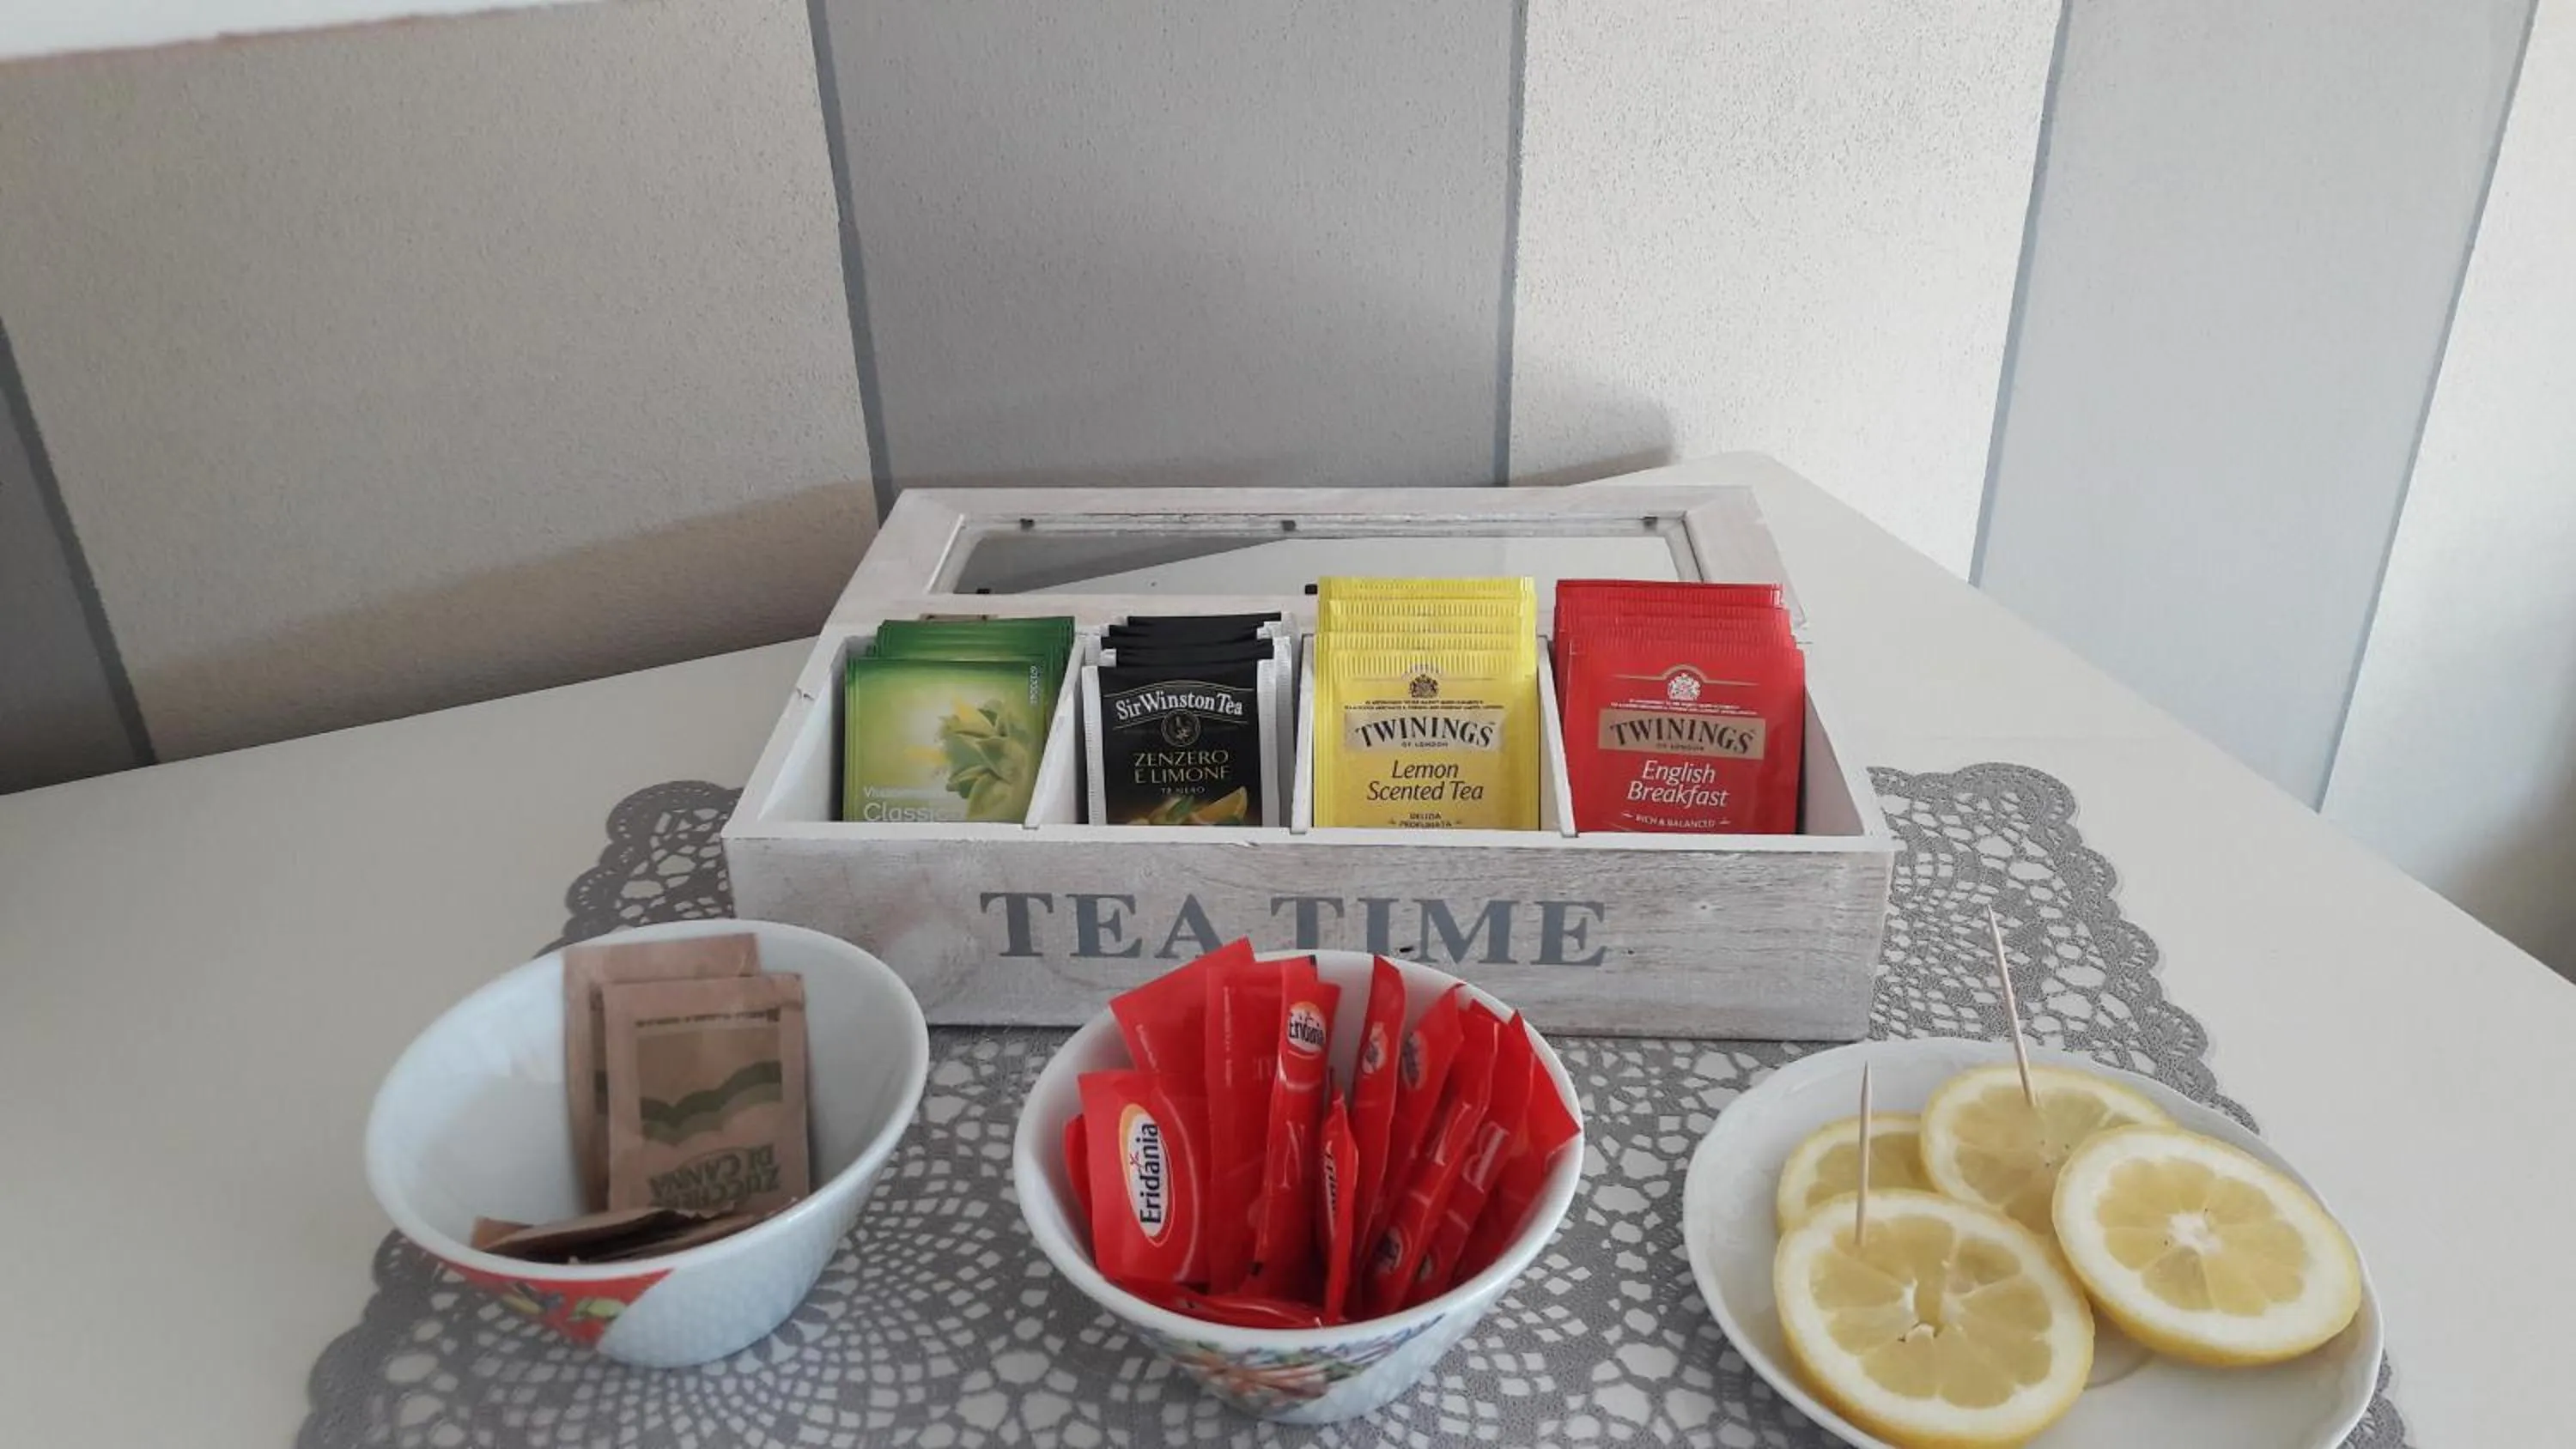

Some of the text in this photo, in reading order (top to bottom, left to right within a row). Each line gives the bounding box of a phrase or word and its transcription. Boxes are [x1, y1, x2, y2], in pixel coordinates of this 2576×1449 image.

[1116, 690, 1243, 720] Sir Winston Tea
[1355, 716, 1494, 748] TWININGS
[1610, 717, 1753, 755] TWININGS
[1133, 749, 1229, 767] ZENZERO
[1391, 760, 1459, 779] Lemon
[1643, 760, 1716, 785] English
[1133, 765, 1230, 784] E LIMONE
[1367, 780, 1484, 801] Scented Tea
[1627, 780, 1729, 809] Breakfast
[980, 892, 1606, 966] TEA TIME
[1139, 1122, 1162, 1224] Eridania
